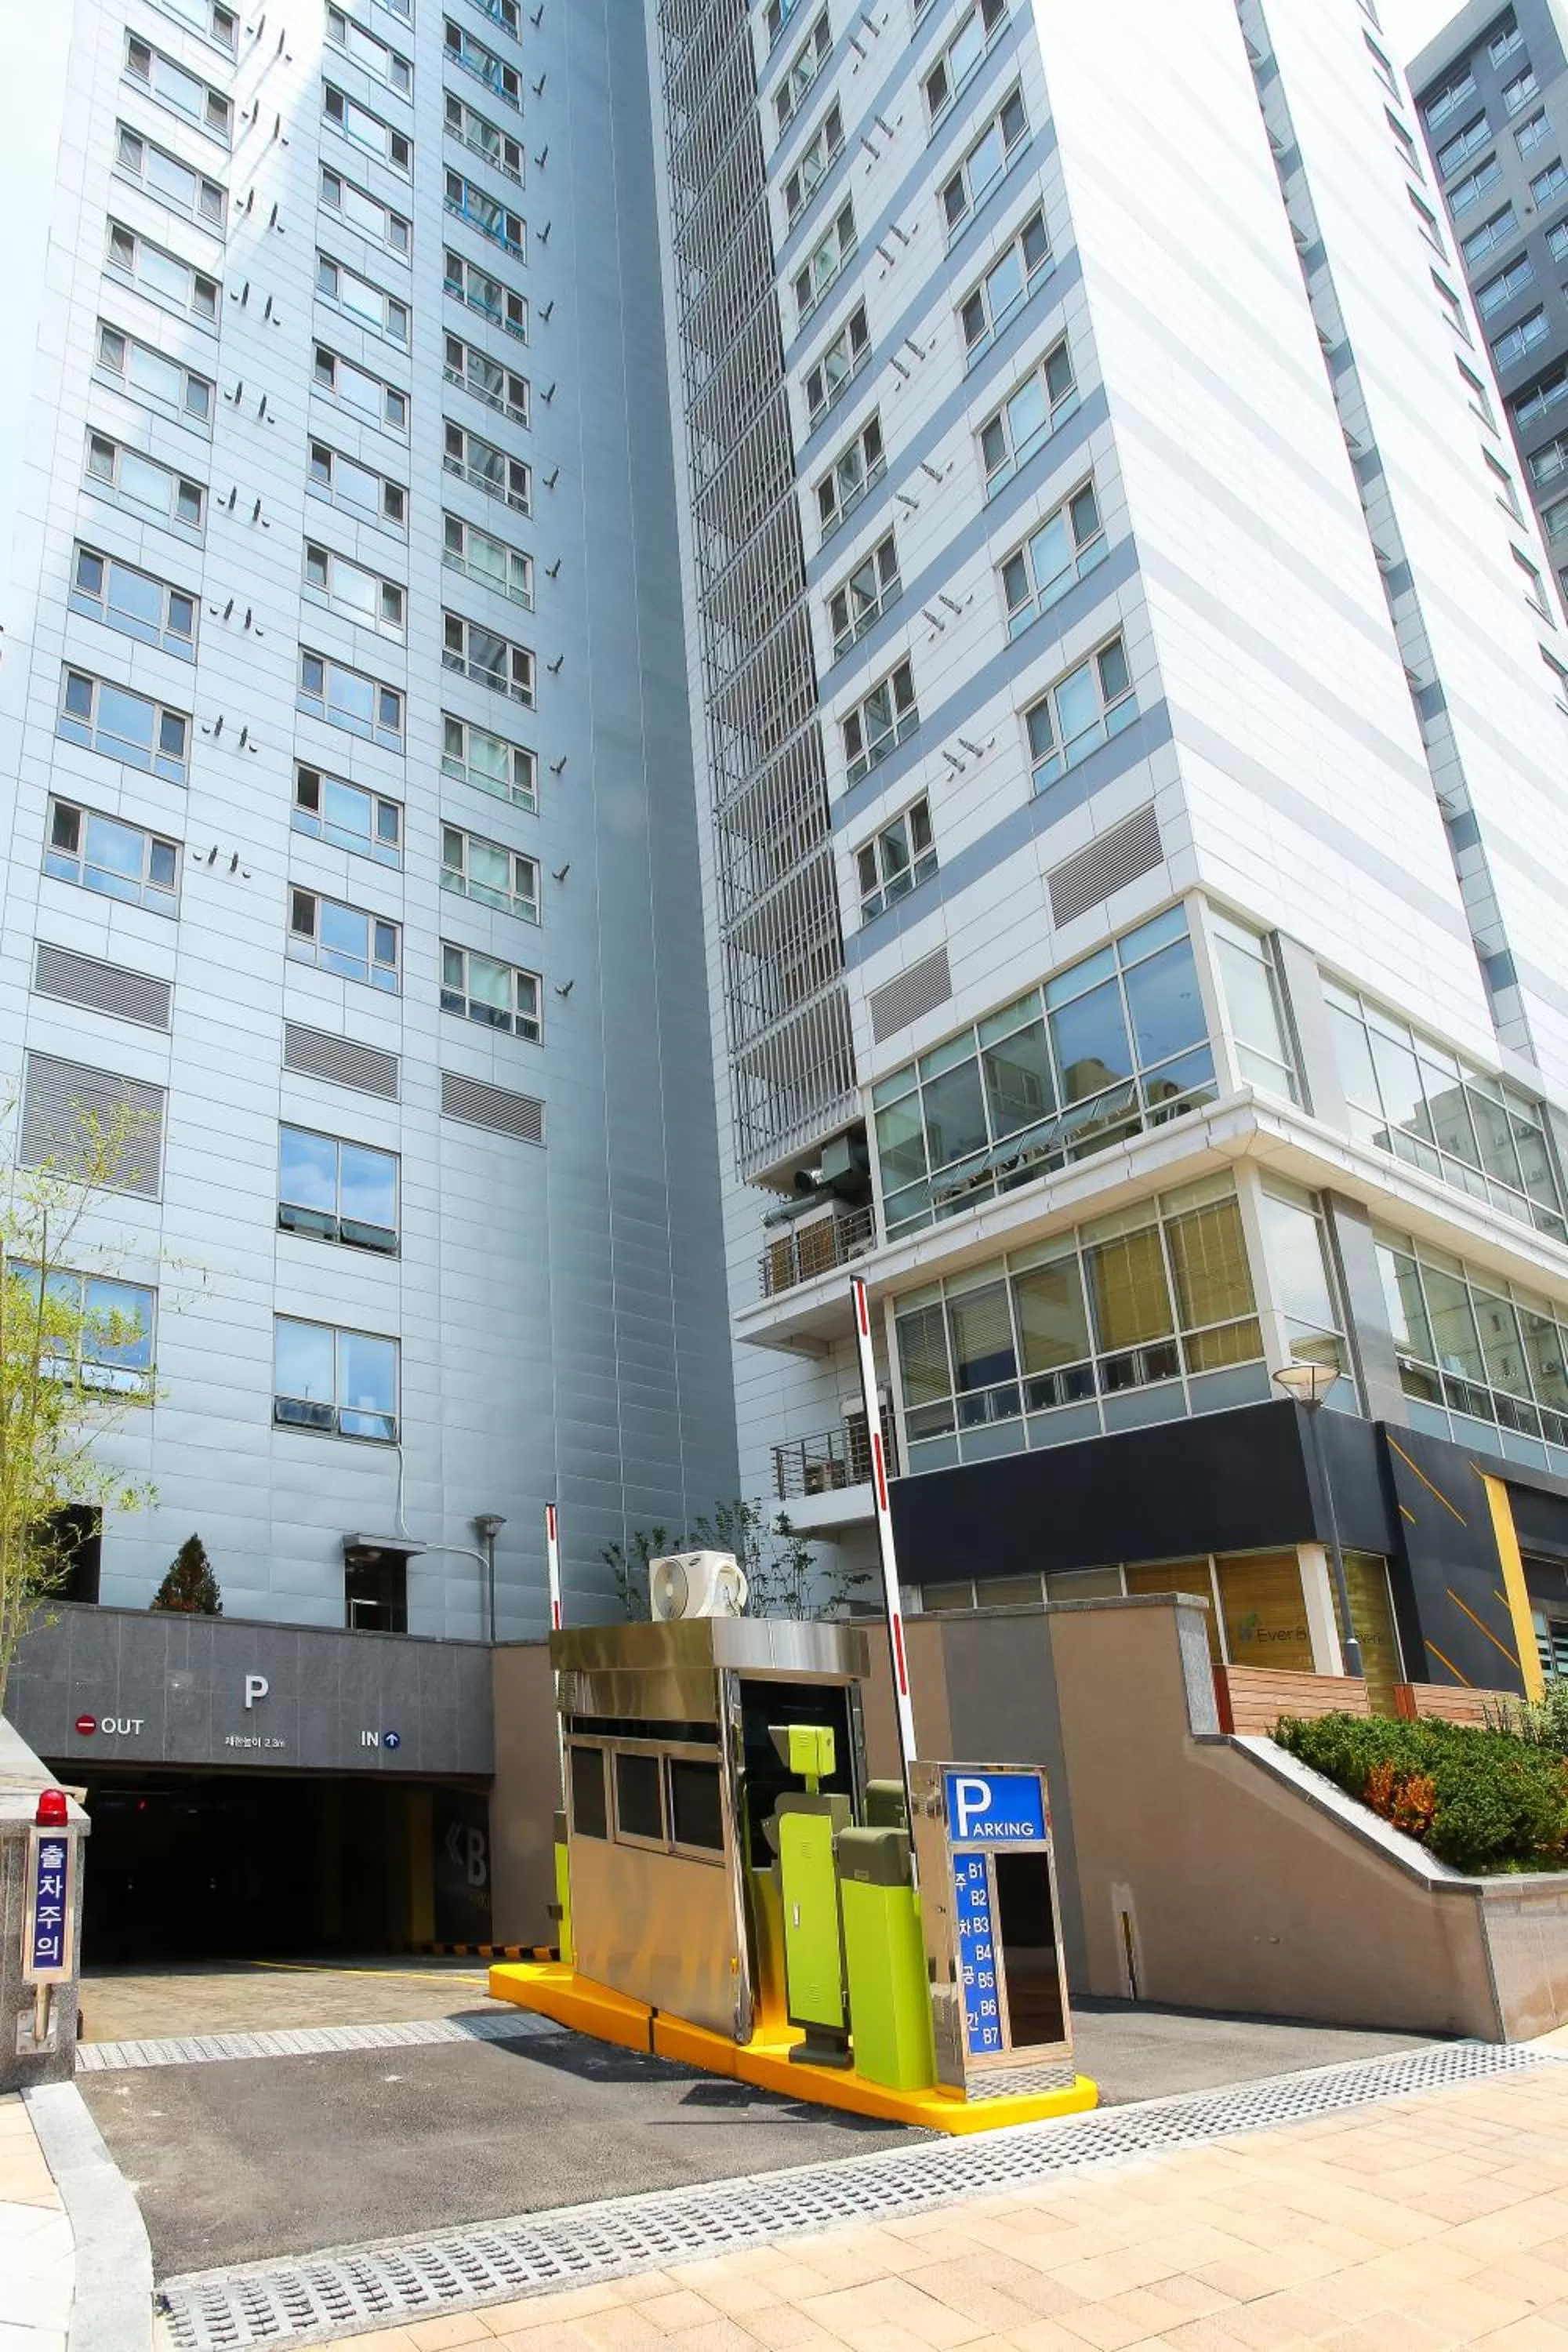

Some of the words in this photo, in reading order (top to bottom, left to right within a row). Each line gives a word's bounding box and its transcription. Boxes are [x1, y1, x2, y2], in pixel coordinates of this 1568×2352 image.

[245, 1675, 269, 1708] P
[101, 1718, 144, 1735] OUT
[361, 1730, 379, 1747] IN
[956, 1778, 1034, 1837] PARKING
[968, 1862, 982, 1879] B1
[36, 1845, 64, 1961] 출차주의
[971, 1889, 987, 1906] B2
[973, 1916, 989, 1933] B3
[975, 1944, 992, 1961] B4
[978, 1971, 994, 1989] B5
[980, 1998, 996, 2016] B6
[982, 2027, 998, 2045] B7
